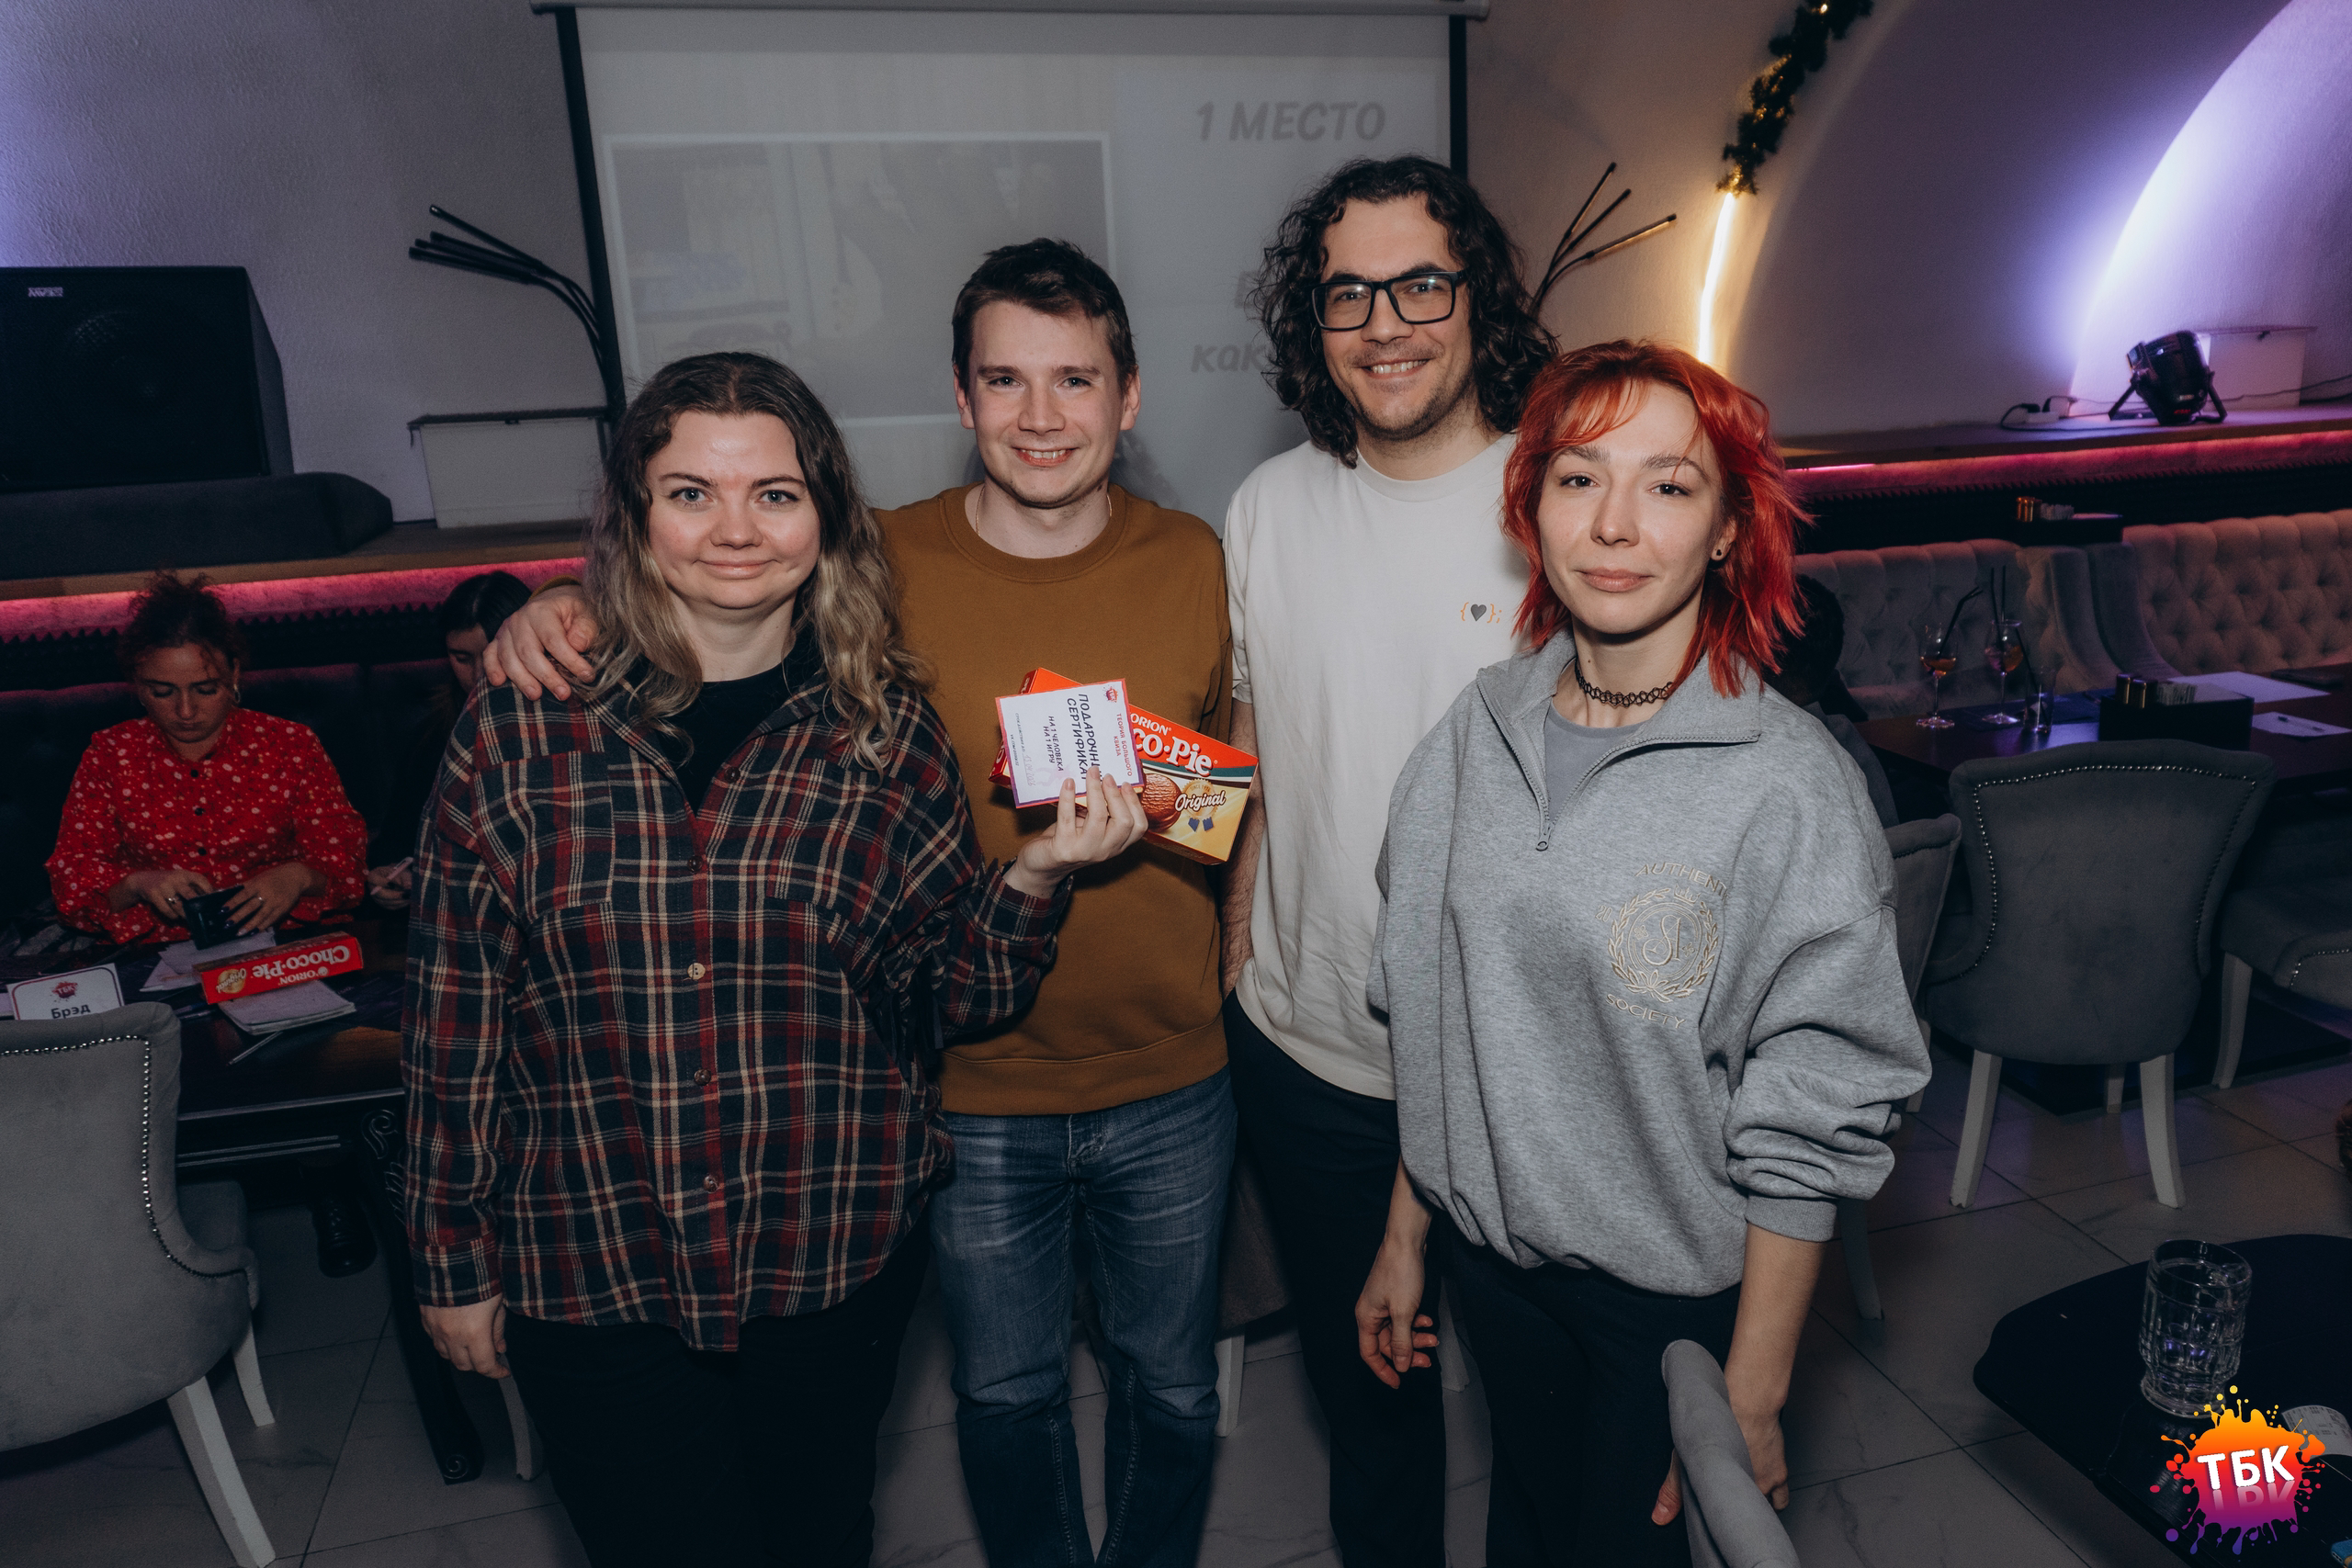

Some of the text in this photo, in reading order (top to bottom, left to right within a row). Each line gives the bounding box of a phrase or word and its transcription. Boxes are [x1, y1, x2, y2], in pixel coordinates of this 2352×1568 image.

[1196, 100, 1386, 142] 1 МЕСТО
[1042, 726, 1051, 738] НА
[1130, 713, 1169, 736] ORION
[1047, 716, 1057, 728] НА
[1052, 733, 1064, 772] ЧЕЛОВЕКА
[1078, 694, 1104, 784] ПОДАРОЧН
[1113, 736, 1122, 757] КВИЗА
[1116, 713, 1133, 777] ТЕОРИЯ БОЛЬШОГО
[1046, 743, 1056, 764] ИГРУ
[1175, 790, 1227, 812] Original
[216, 967, 247, 993] Original
[279, 969, 317, 985] ORION
[51, 1004, 91, 1020] Брэд
[1607, 993, 1686, 1029] SOCIETY
